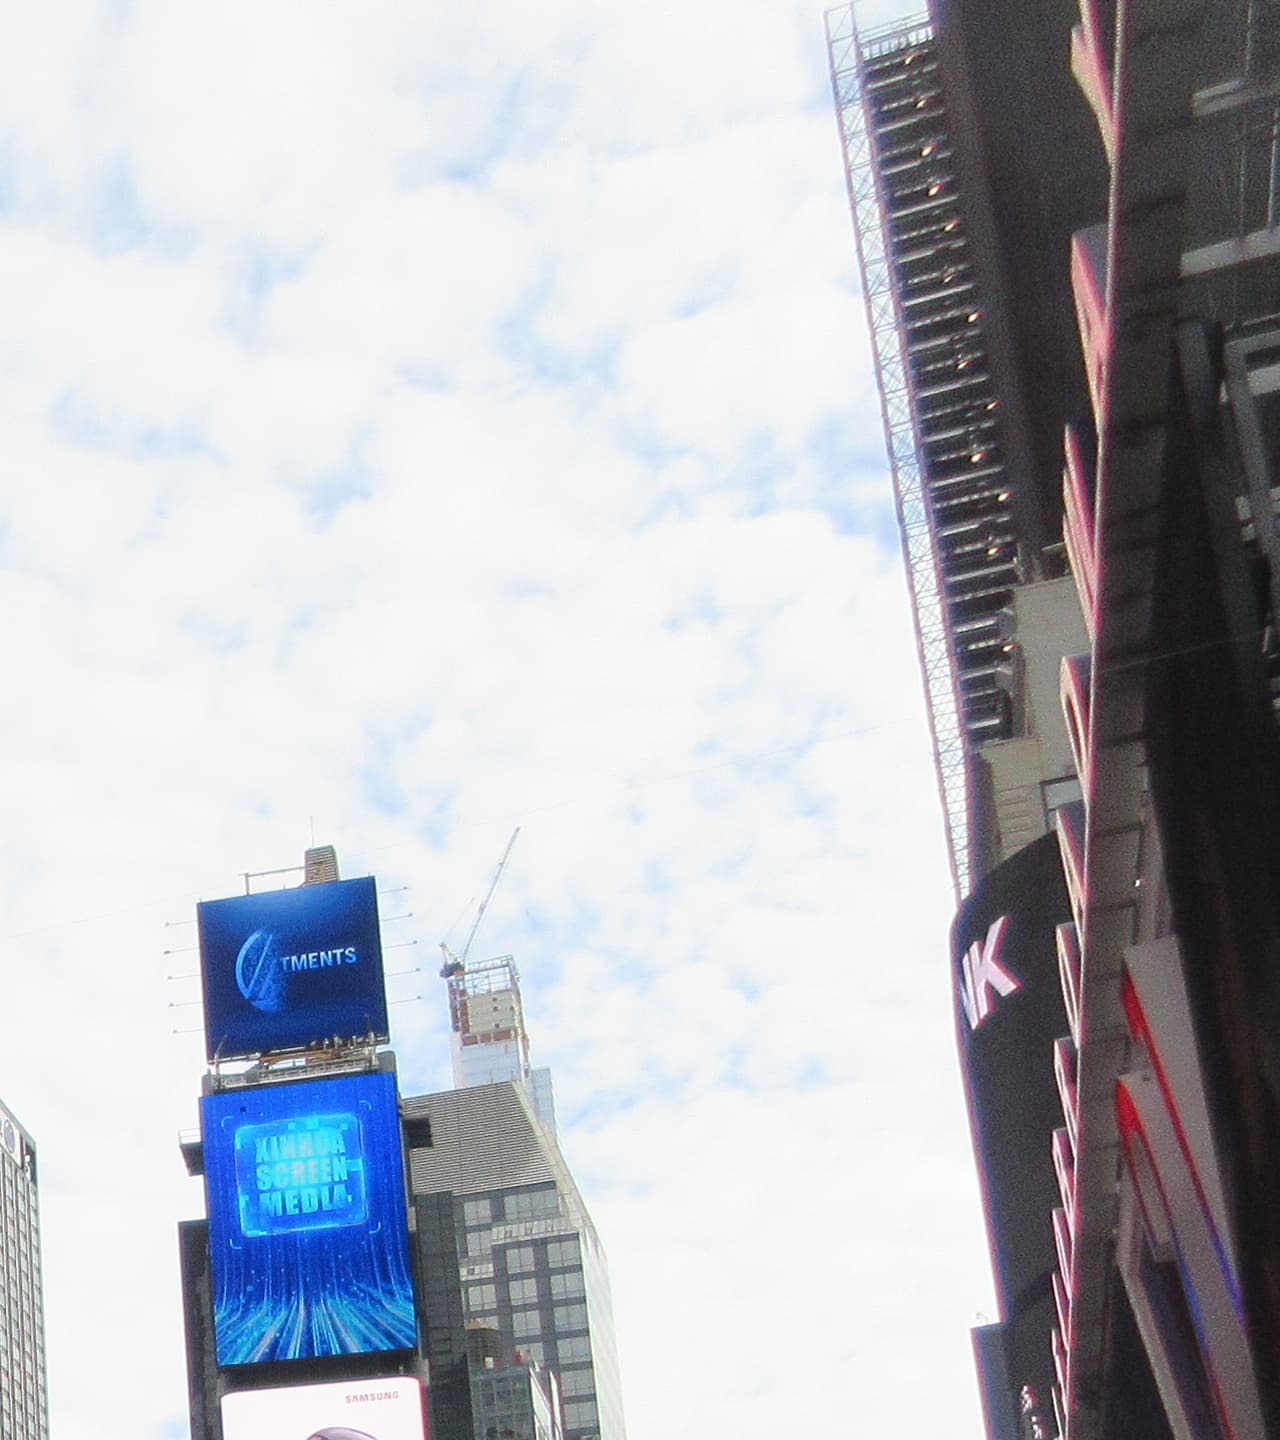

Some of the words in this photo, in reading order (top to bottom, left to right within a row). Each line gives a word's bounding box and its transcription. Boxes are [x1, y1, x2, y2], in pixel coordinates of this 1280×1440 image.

[281, 947, 358, 973] TMENTS
[255, 1156, 350, 1191] SCREEN
[344, 1390, 400, 1404] SAMSUNG
